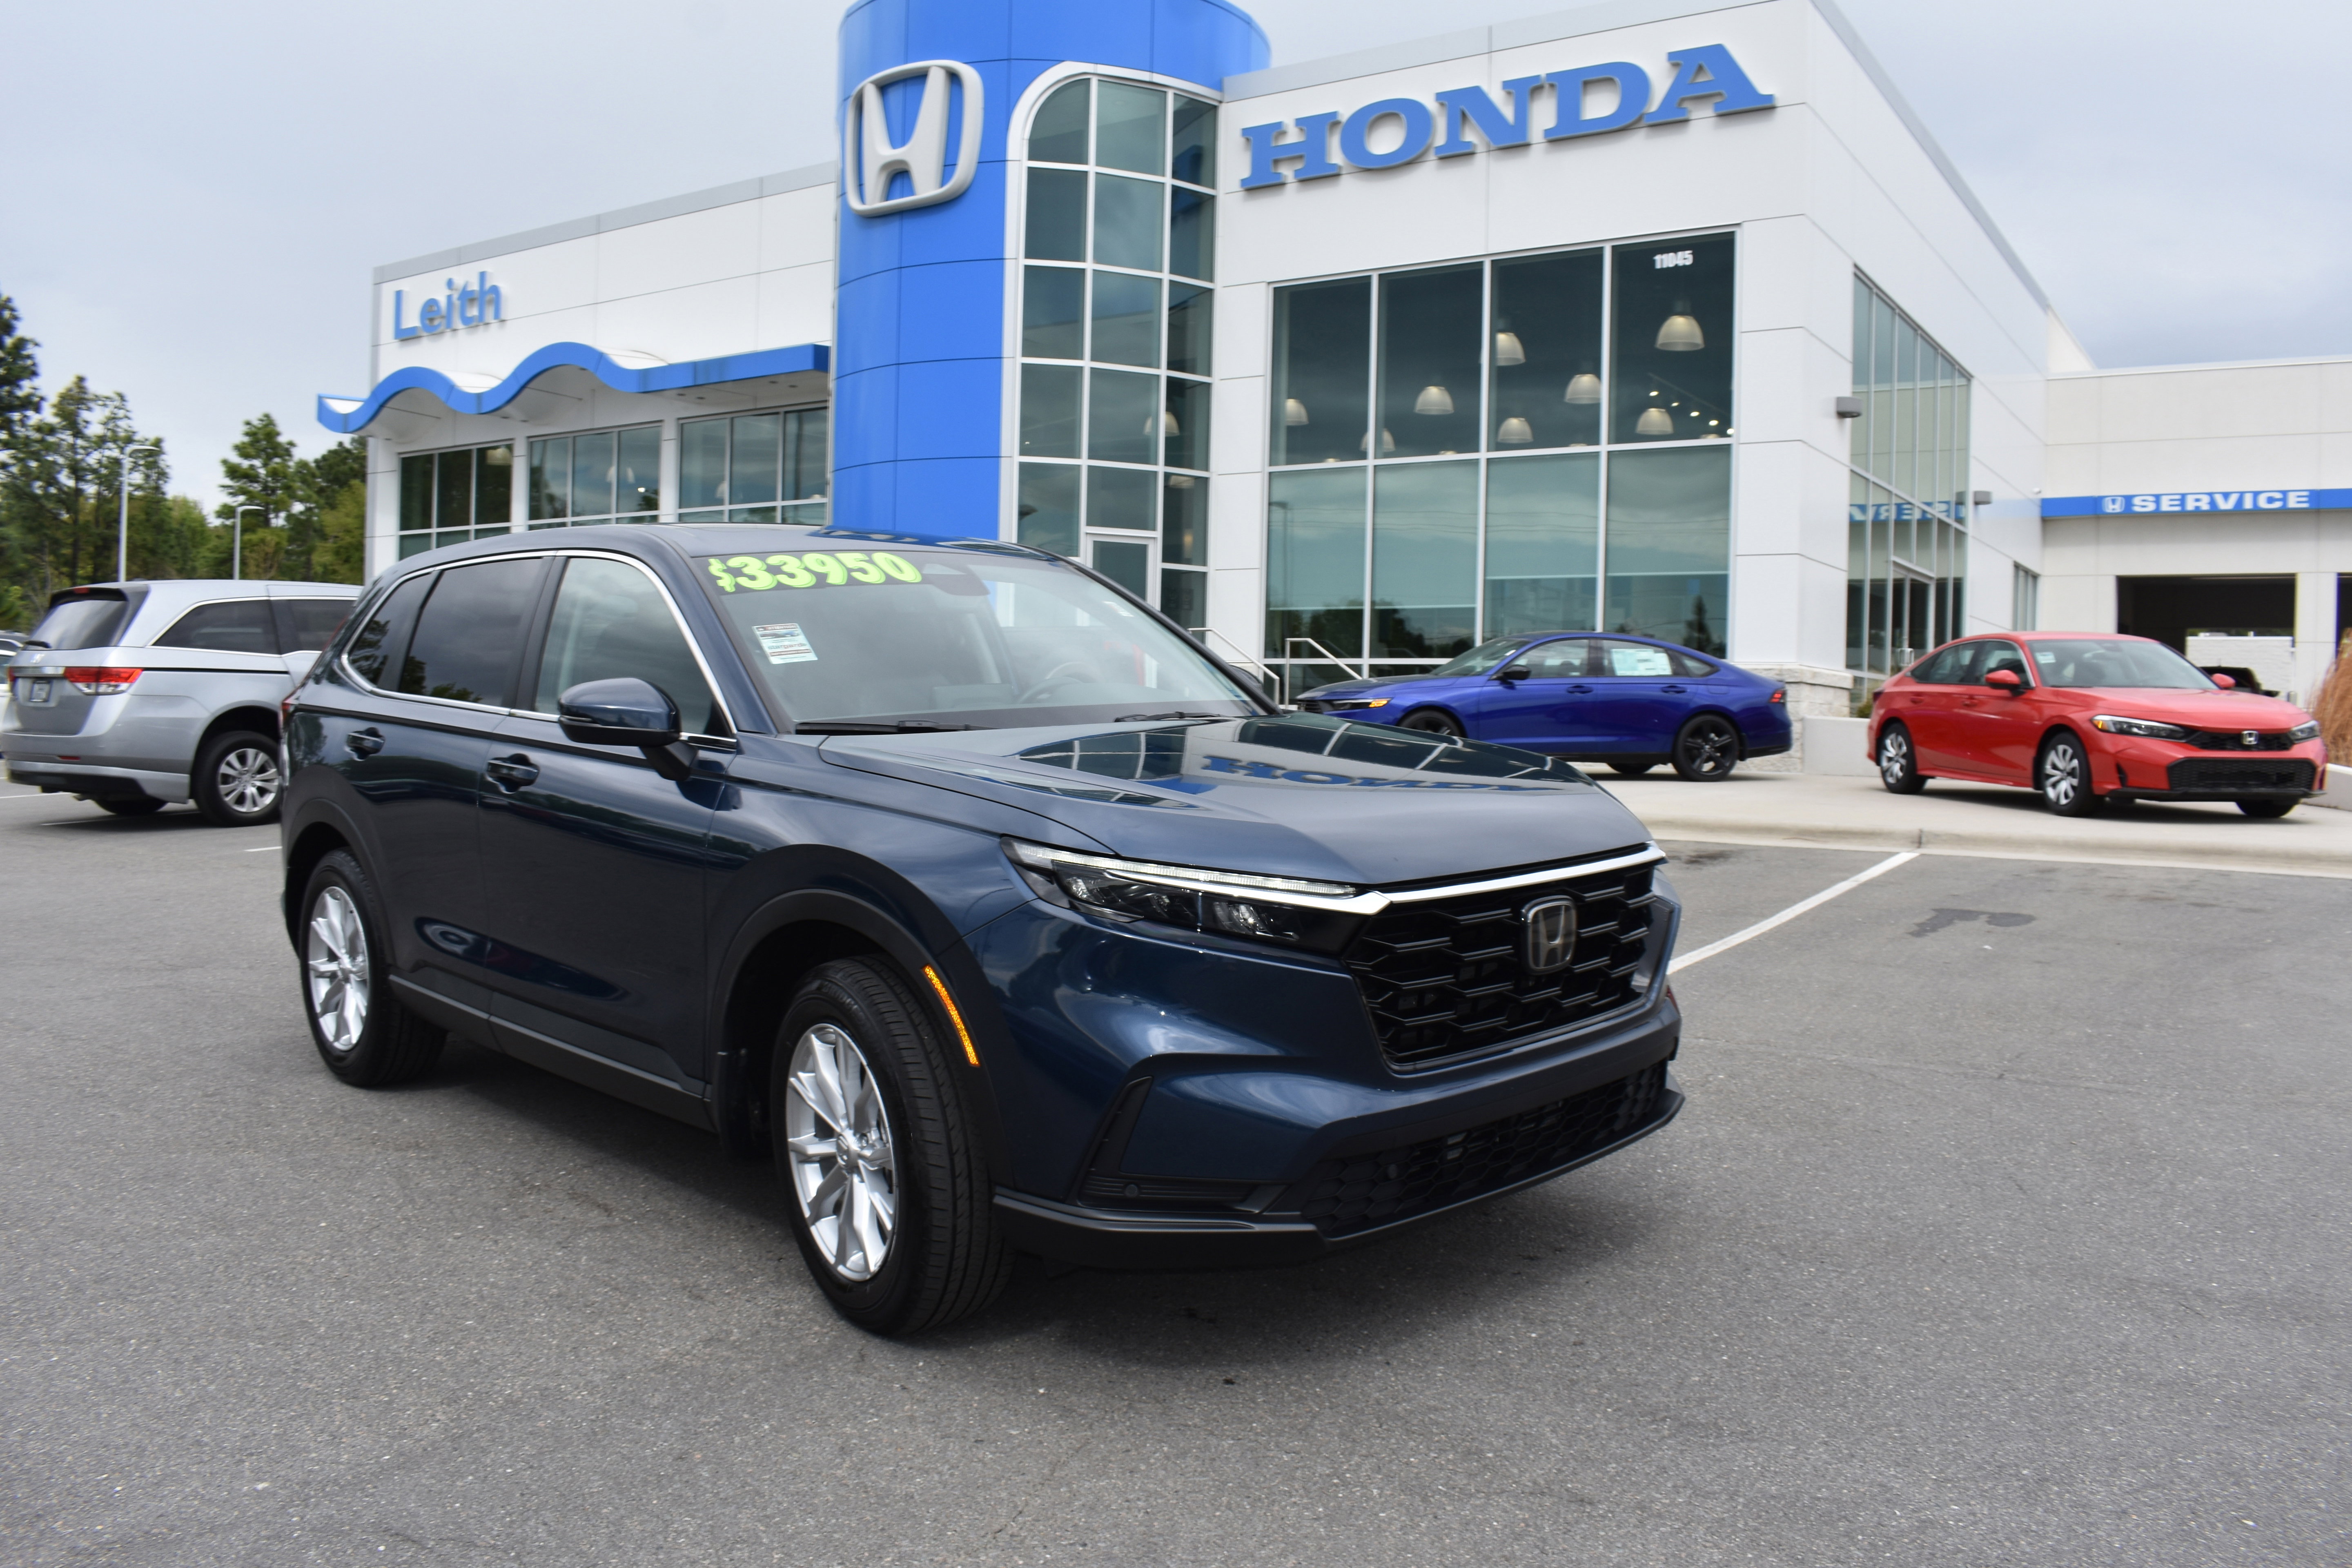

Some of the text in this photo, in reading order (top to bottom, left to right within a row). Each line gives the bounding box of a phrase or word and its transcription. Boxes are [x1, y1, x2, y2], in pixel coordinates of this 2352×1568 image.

[1240, 43, 1776, 190] HONDA
[1653, 250, 1693, 269] 11045
[394, 270, 502, 340] Leith
[2131, 491, 2310, 512] SERVICE
[708, 552, 922, 592] $33950
